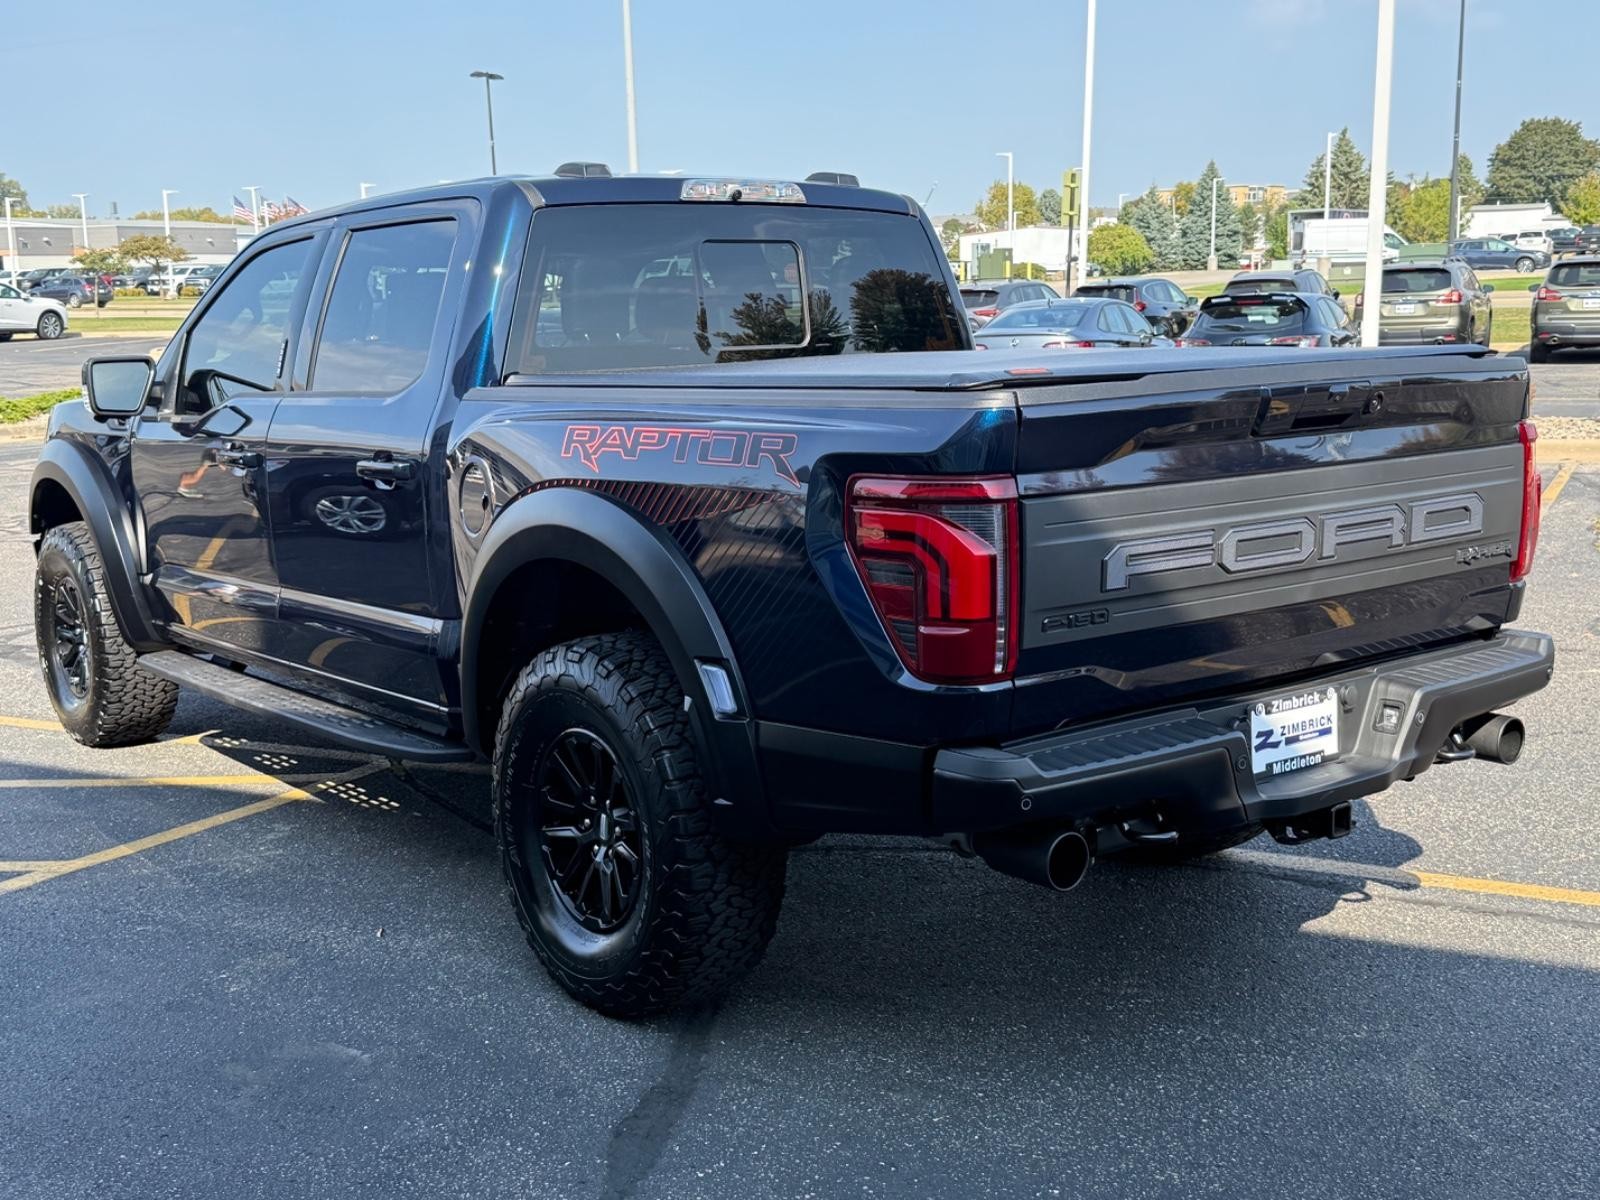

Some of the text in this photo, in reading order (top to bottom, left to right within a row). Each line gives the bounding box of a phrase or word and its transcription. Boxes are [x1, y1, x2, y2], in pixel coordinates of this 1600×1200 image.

[561, 425, 801, 488] RAPTOR
[1102, 491, 1485, 592] FORD
[1271, 691, 1321, 713] Zimbrick
[1280, 714, 1333, 736] ZIMBRICK
[1272, 754, 1323, 774] Middleton
